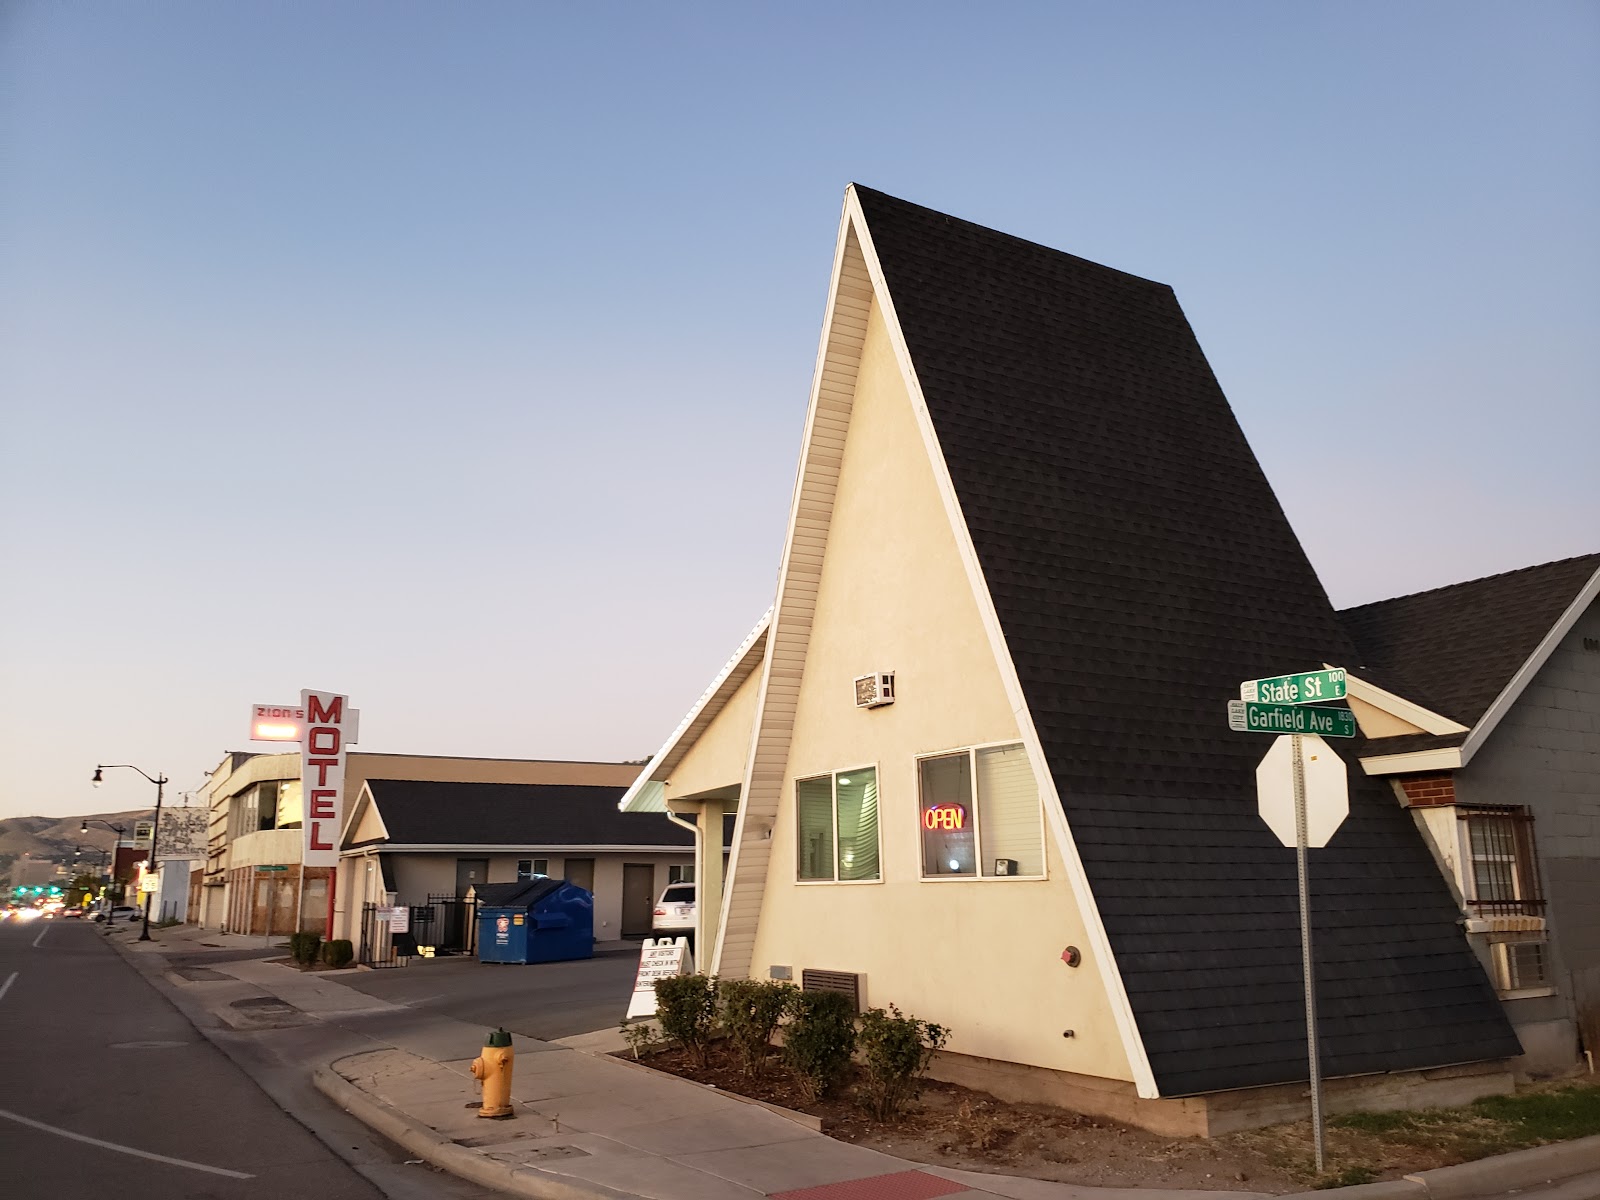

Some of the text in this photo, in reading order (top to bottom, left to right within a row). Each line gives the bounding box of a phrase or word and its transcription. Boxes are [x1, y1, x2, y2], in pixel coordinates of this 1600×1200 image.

[1328, 671, 1344, 683] 100
[1261, 676, 1322, 703] State St
[1334, 685, 1341, 696] E
[1249, 706, 1333, 732] Garfield Ave
[1344, 724, 1350, 735] S
[307, 695, 343, 850] MOTEL
[925, 808, 962, 830] OPEN
